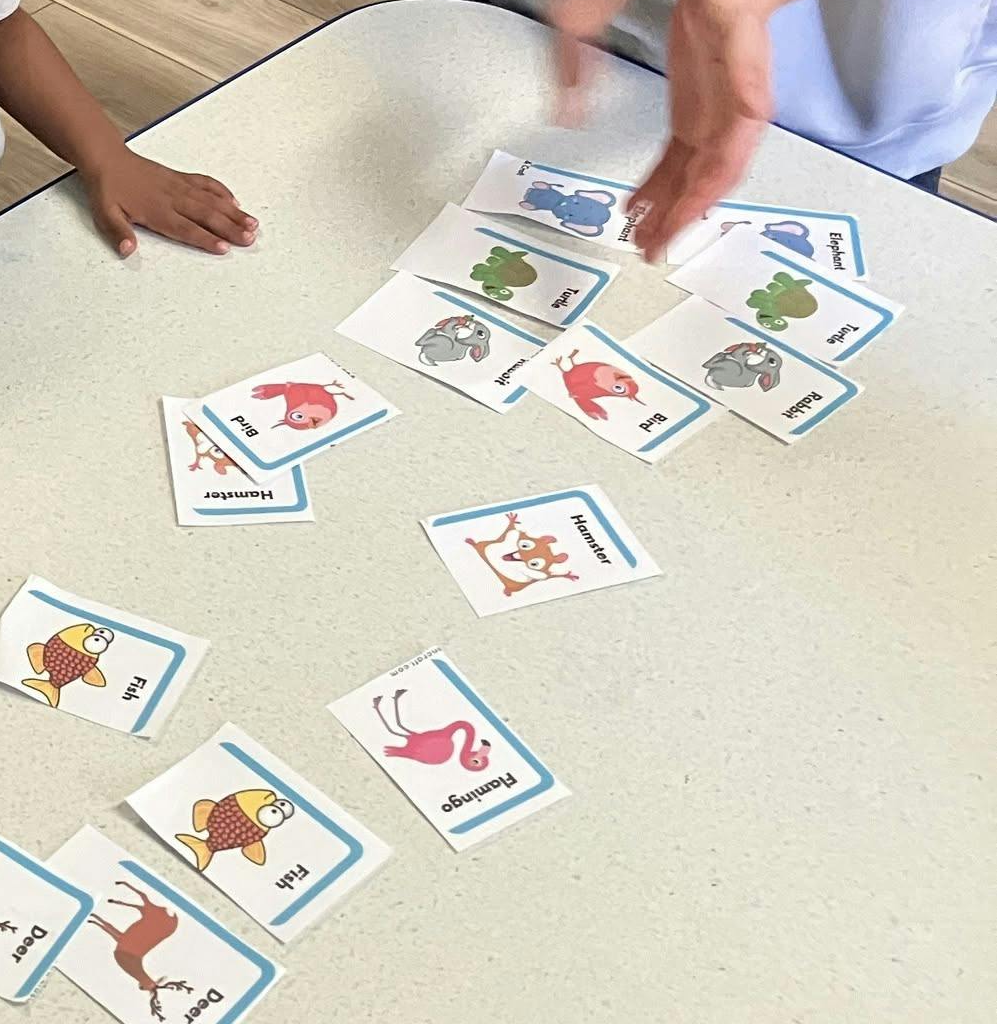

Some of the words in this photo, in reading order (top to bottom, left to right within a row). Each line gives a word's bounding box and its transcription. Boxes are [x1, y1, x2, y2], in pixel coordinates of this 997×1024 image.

[826, 232, 847, 271] Elephant
[551, 287, 580, 309] Turtle
[826, 323, 860, 345] Turtle
[781, 391, 824, 420] Rabbit
[230, 415, 260, 438] Bird
[638, 412, 669, 434] Bird
[203, 488, 274, 501] Hamster
[569, 513, 612, 566] Hamster
[121, 675, 149, 702] Fish
[440, 773, 518, 815] Flamingo
[274, 862, 311, 891] Fish
[11, 923, 48, 964] Deer
[184, 987, 224, 1024] Deer
